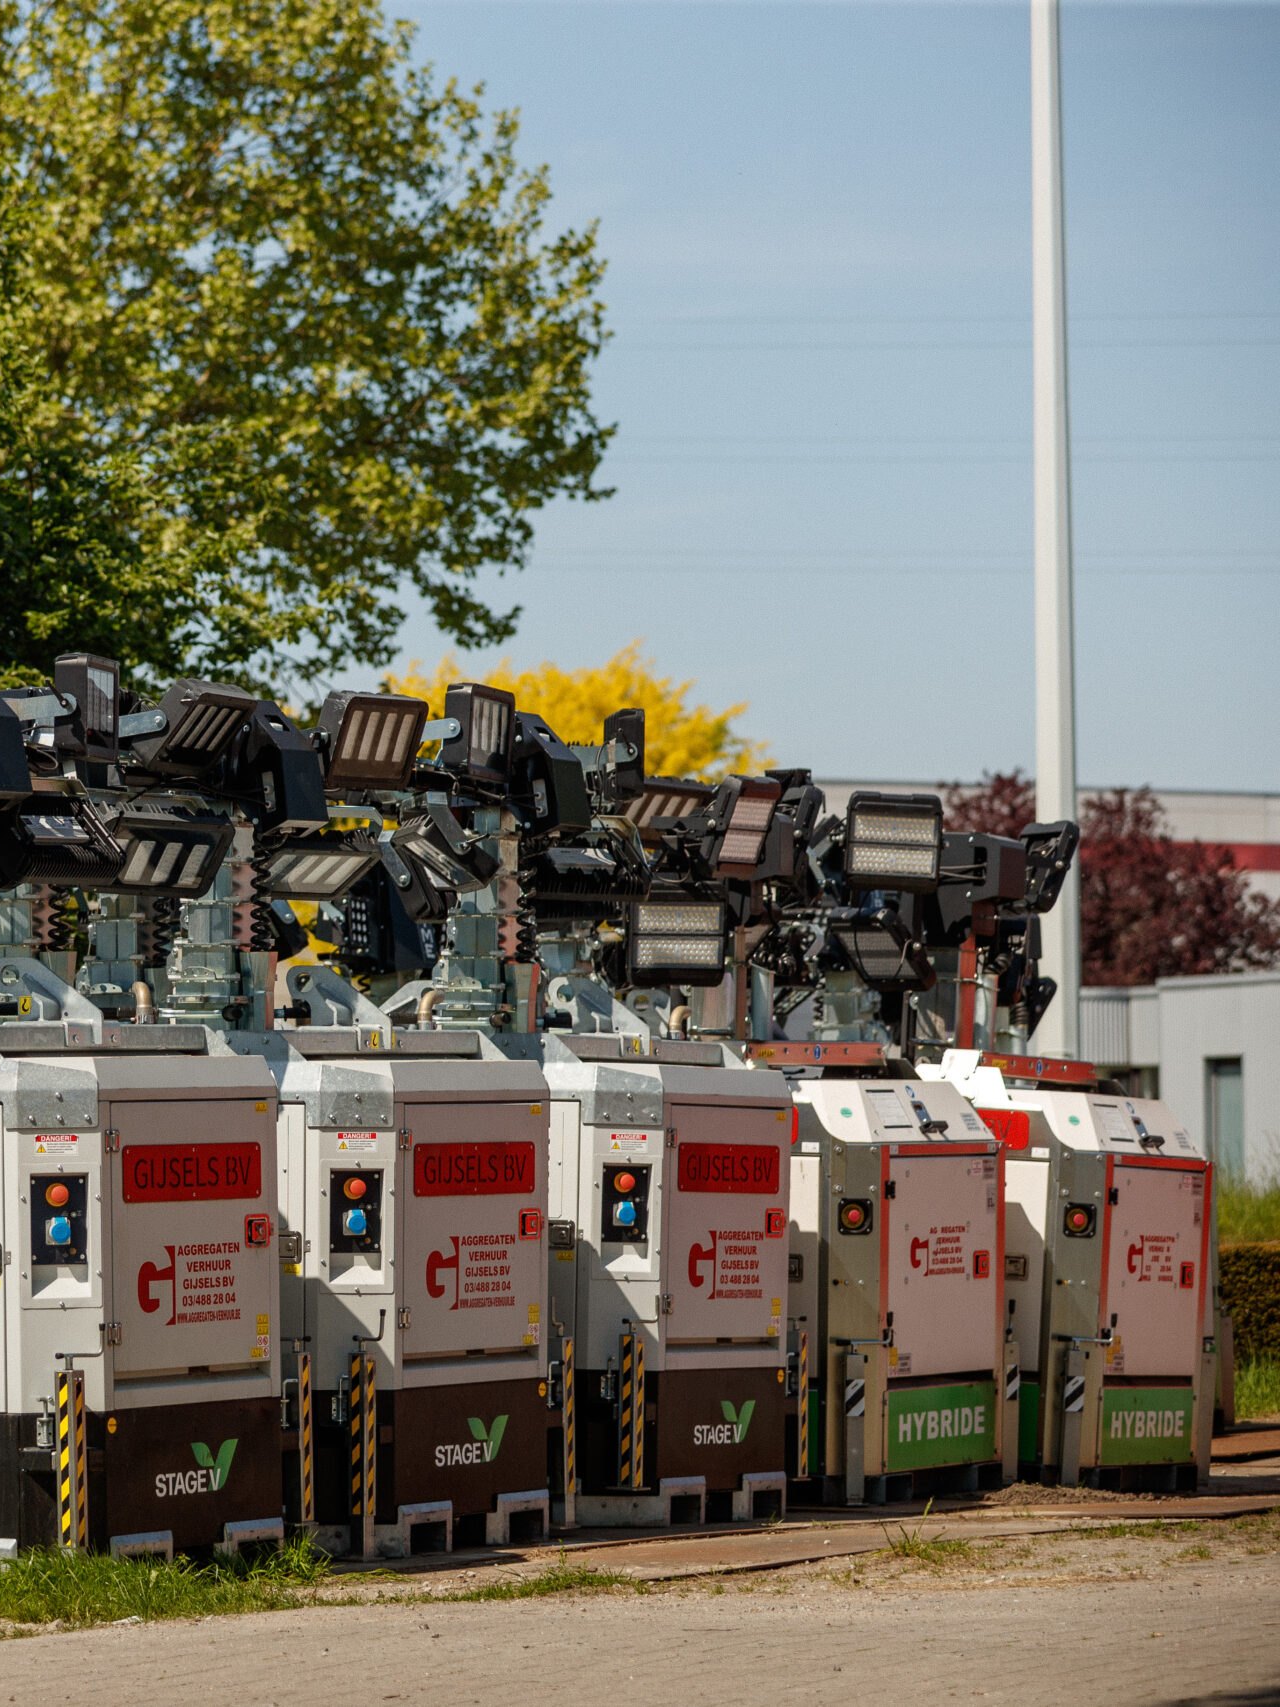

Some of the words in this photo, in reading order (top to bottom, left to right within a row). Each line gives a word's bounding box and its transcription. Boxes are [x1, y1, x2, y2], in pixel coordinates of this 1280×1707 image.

[134, 1156, 219, 1189] GIJSELS
[226, 1156, 251, 1185] BV
[424, 1155, 498, 1184] GIJSELS
[504, 1154, 527, 1182] BV
[687, 1154, 749, 1182] GIJSELS
[753, 1156, 773, 1182] BV
[461, 1234, 516, 1246] AGGREGATEN
[718, 1231, 764, 1241] AGGREGATEN
[177, 1242, 240, 1256] AGGREGATEN
[469, 1250, 507, 1262] VERHUUR
[724, 1245, 757, 1255] VERHUUR
[186, 1259, 231, 1273] VERHUUR
[465, 1266, 499, 1278] GIJSELS
[500, 1266, 510, 1276] BV
[721, 1260, 749, 1270] GIJSELS
[749, 1260, 759, 1270] BV
[183, 1277, 220, 1290] GIJSELS
[223, 1276, 235, 1287] BV
[742, 1274, 750, 1284] 28
[751, 1274, 759, 1284] 04
[464, 1282, 490, 1294] 03/488
[491, 1281, 501, 1292] 28
[502, 1281, 511, 1291] 04
[182, 1294, 211, 1307] 03/488
[213, 1294, 224, 1305] 28
[225, 1292, 236, 1304] 04
[898, 1405, 985, 1443] HYBRIDE
[1111, 1410, 1184, 1439] HYBRIDE
[694, 1424, 731, 1445] STAGE
[733, 1424, 742, 1443] V
[435, 1442, 481, 1467] STAGE
[483, 1441, 493, 1462] V
[155, 1470, 207, 1498] STAGE
[209, 1468, 221, 1491] V
